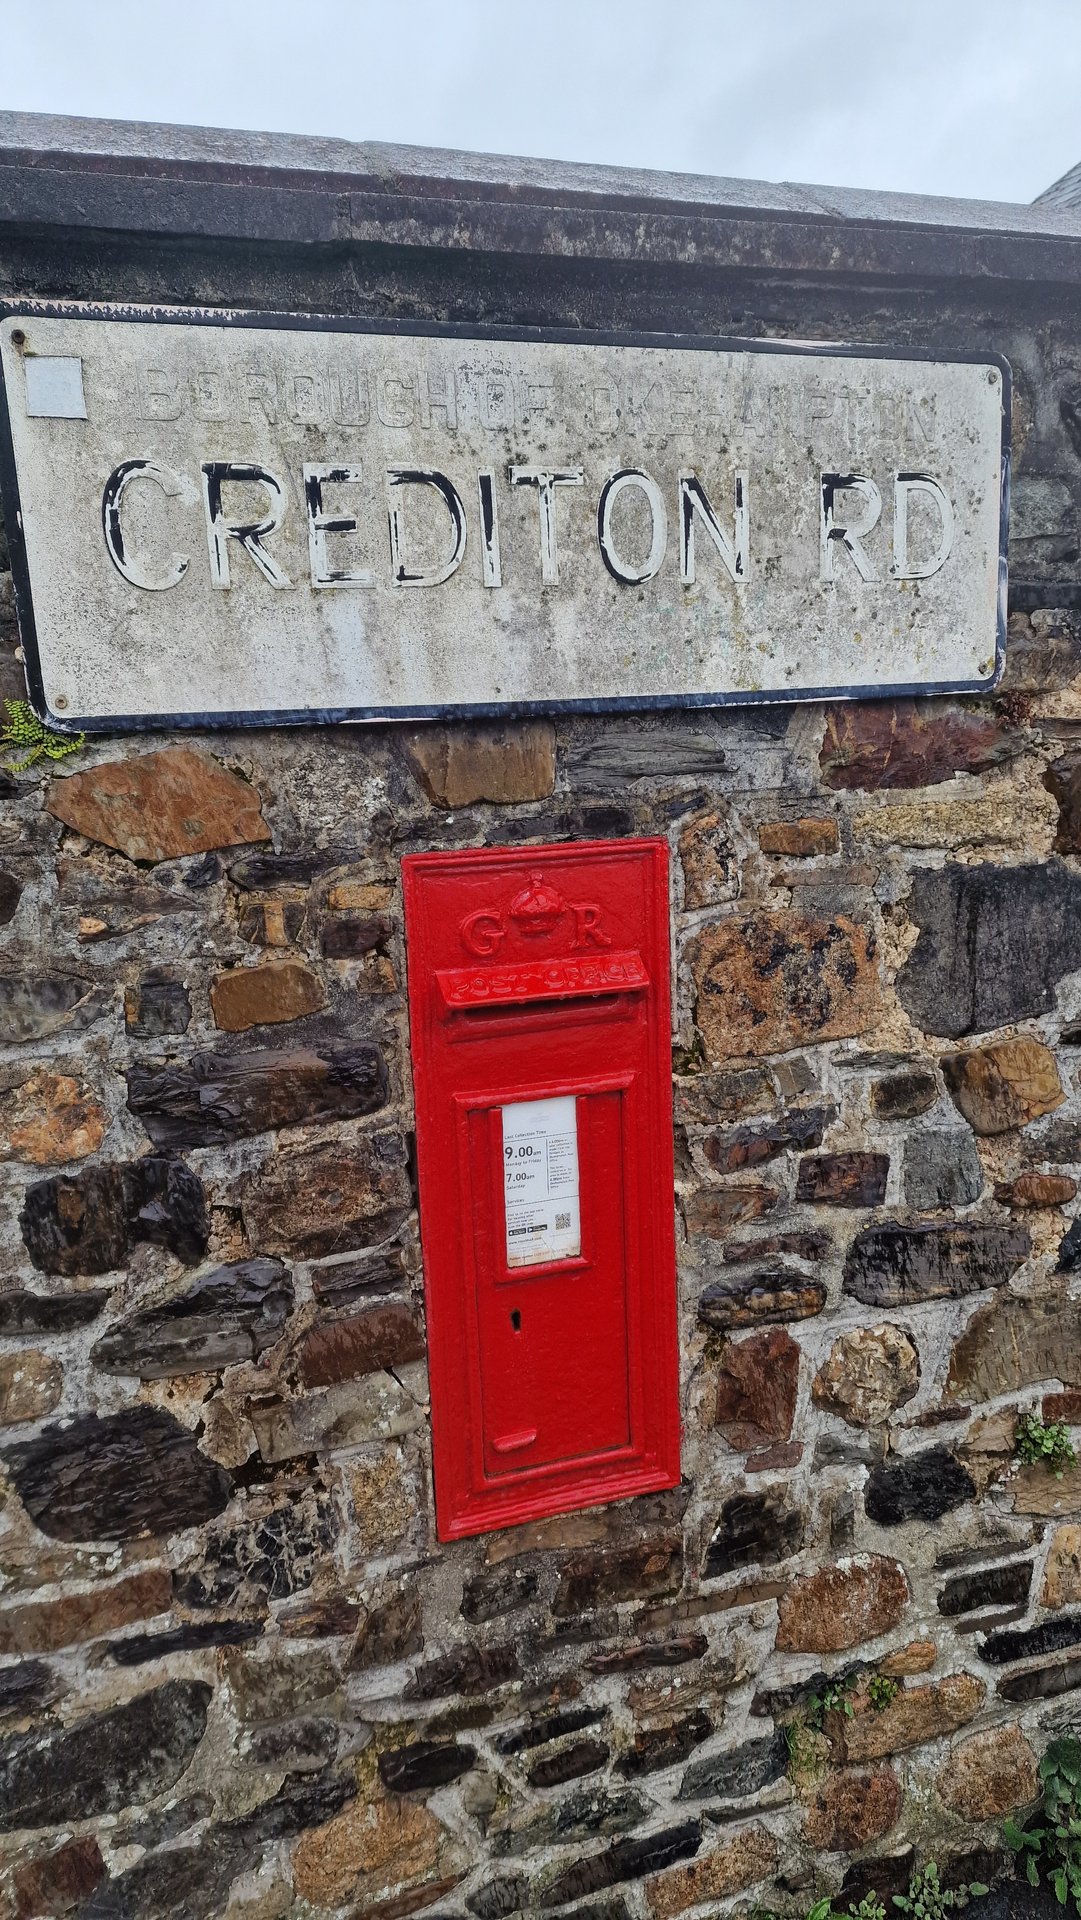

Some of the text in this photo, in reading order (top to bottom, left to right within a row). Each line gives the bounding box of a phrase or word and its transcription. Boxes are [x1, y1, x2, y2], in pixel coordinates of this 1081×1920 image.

[136, 358, 459, 430] BOROUGH
[101, 458, 955, 592] CREDITON RD
[459, 902, 613, 956] G R
[544, 961, 643, 988] OFFICE
